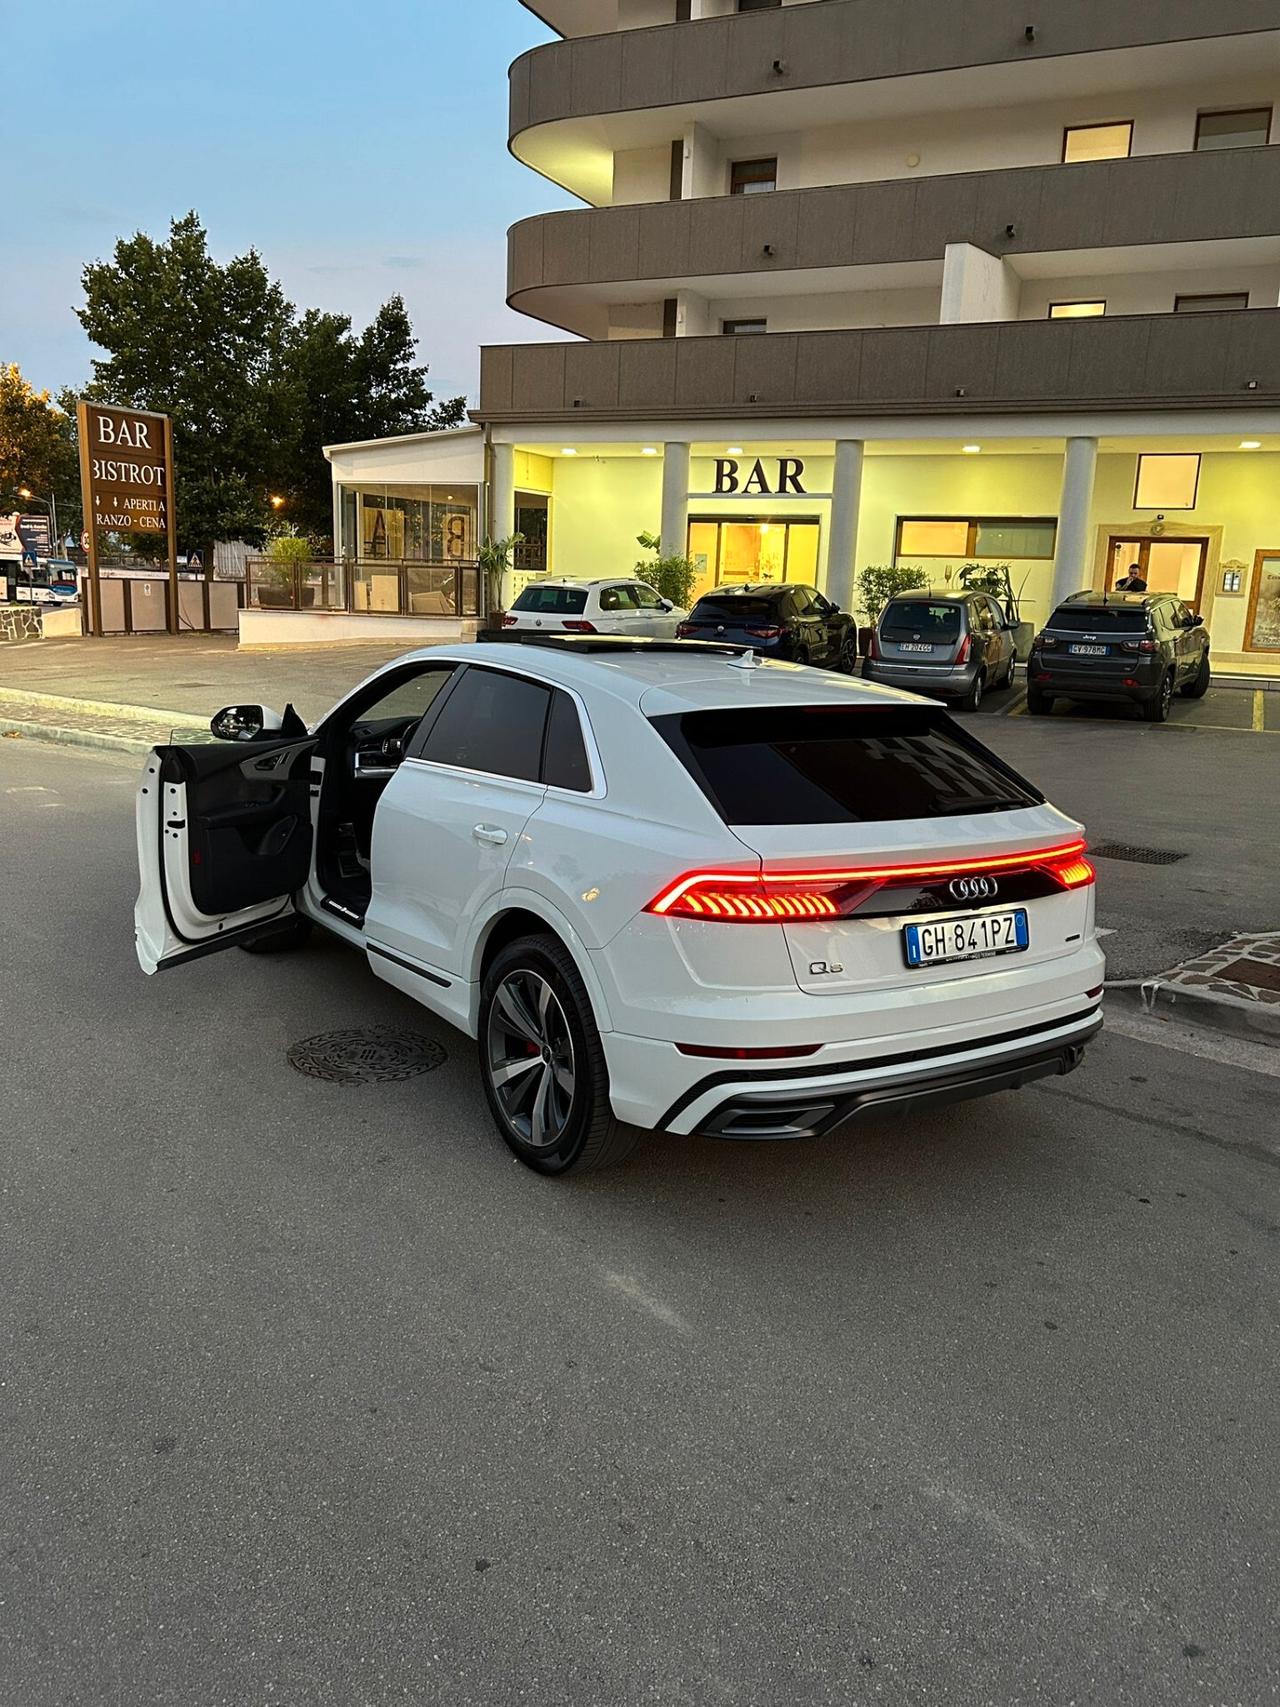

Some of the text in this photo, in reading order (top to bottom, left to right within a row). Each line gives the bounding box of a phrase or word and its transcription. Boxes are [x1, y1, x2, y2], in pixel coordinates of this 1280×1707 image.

[97, 416, 151, 449] BAR
[712, 457, 807, 494] BAR
[123, 497, 157, 511] APERTI
[140, 517, 166, 528] CENA
[921, 925, 948, 957] GH
[953, 917, 1016, 950] 841PZ
